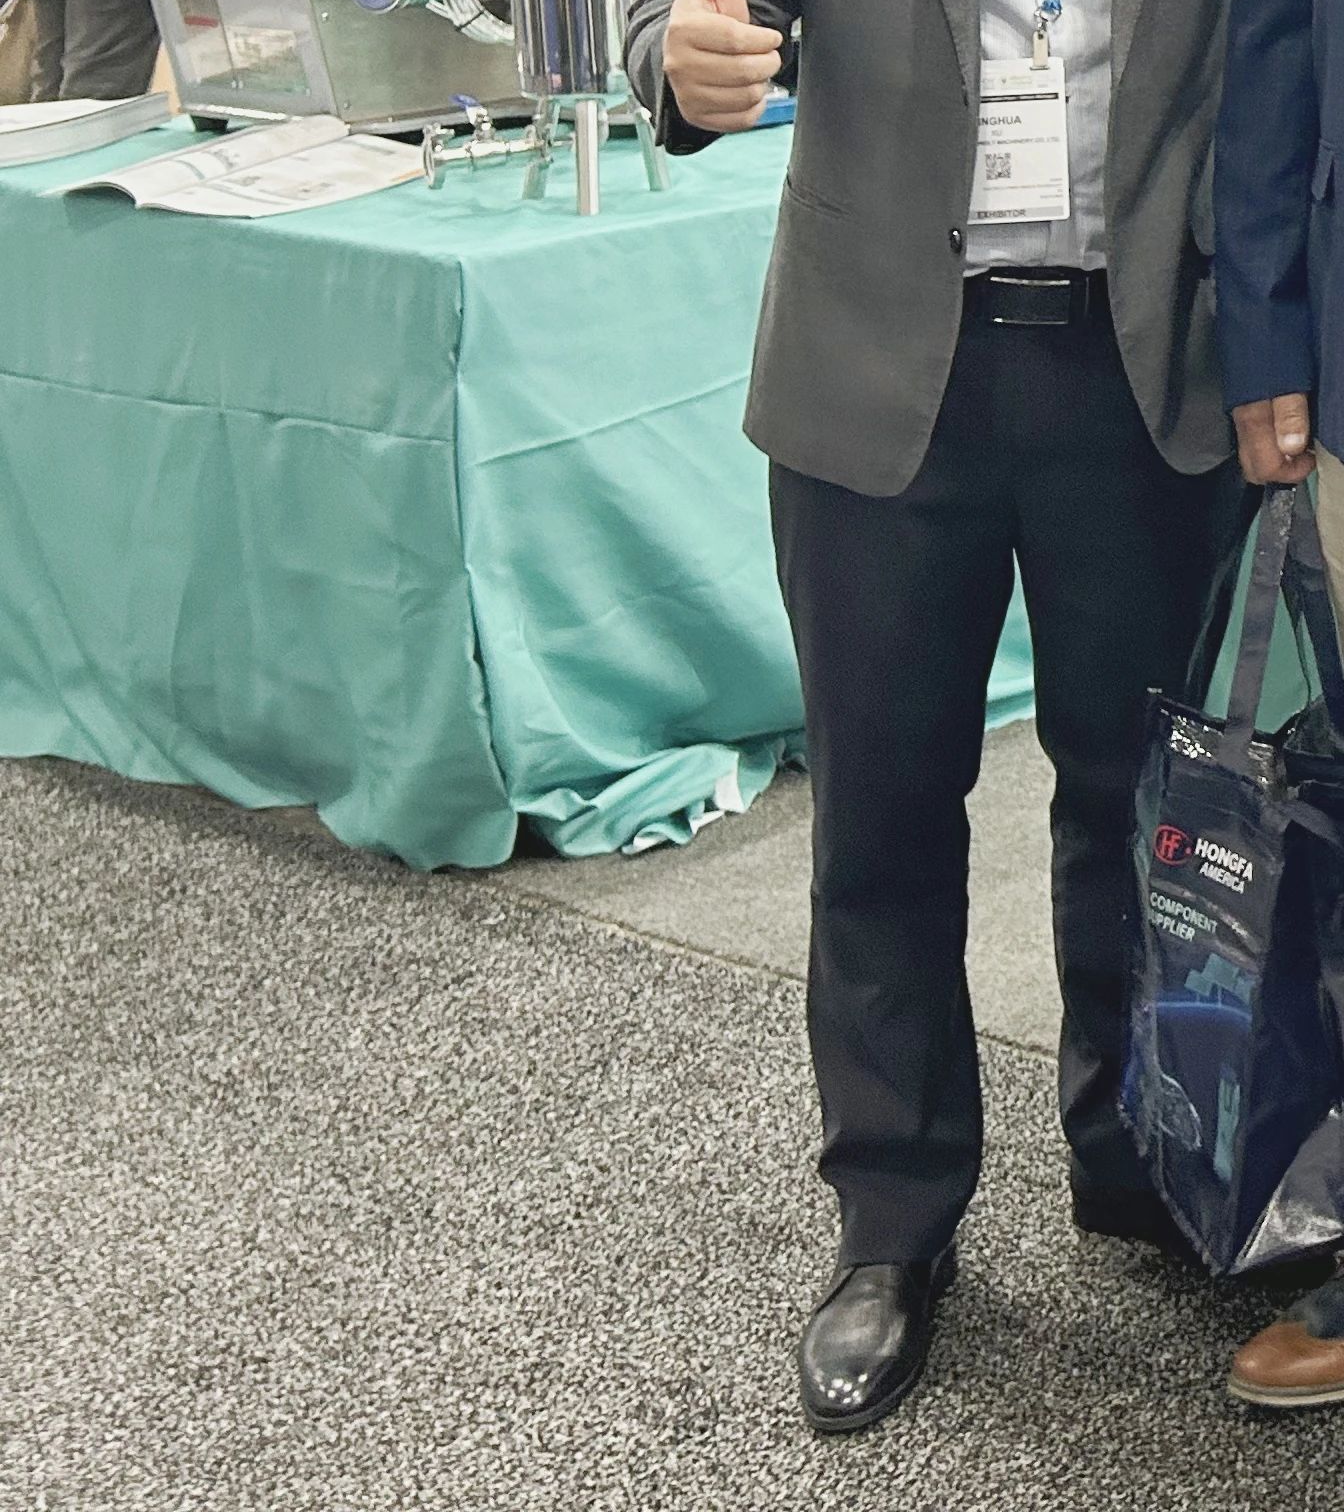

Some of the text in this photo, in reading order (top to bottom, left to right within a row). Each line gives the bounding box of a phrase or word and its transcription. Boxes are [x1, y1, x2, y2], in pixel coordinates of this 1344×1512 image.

[1194, 838, 1254, 882] HONGFA
[1199, 861, 1246, 894] AMERICA
[1150, 891, 1218, 934] COMPONENT
